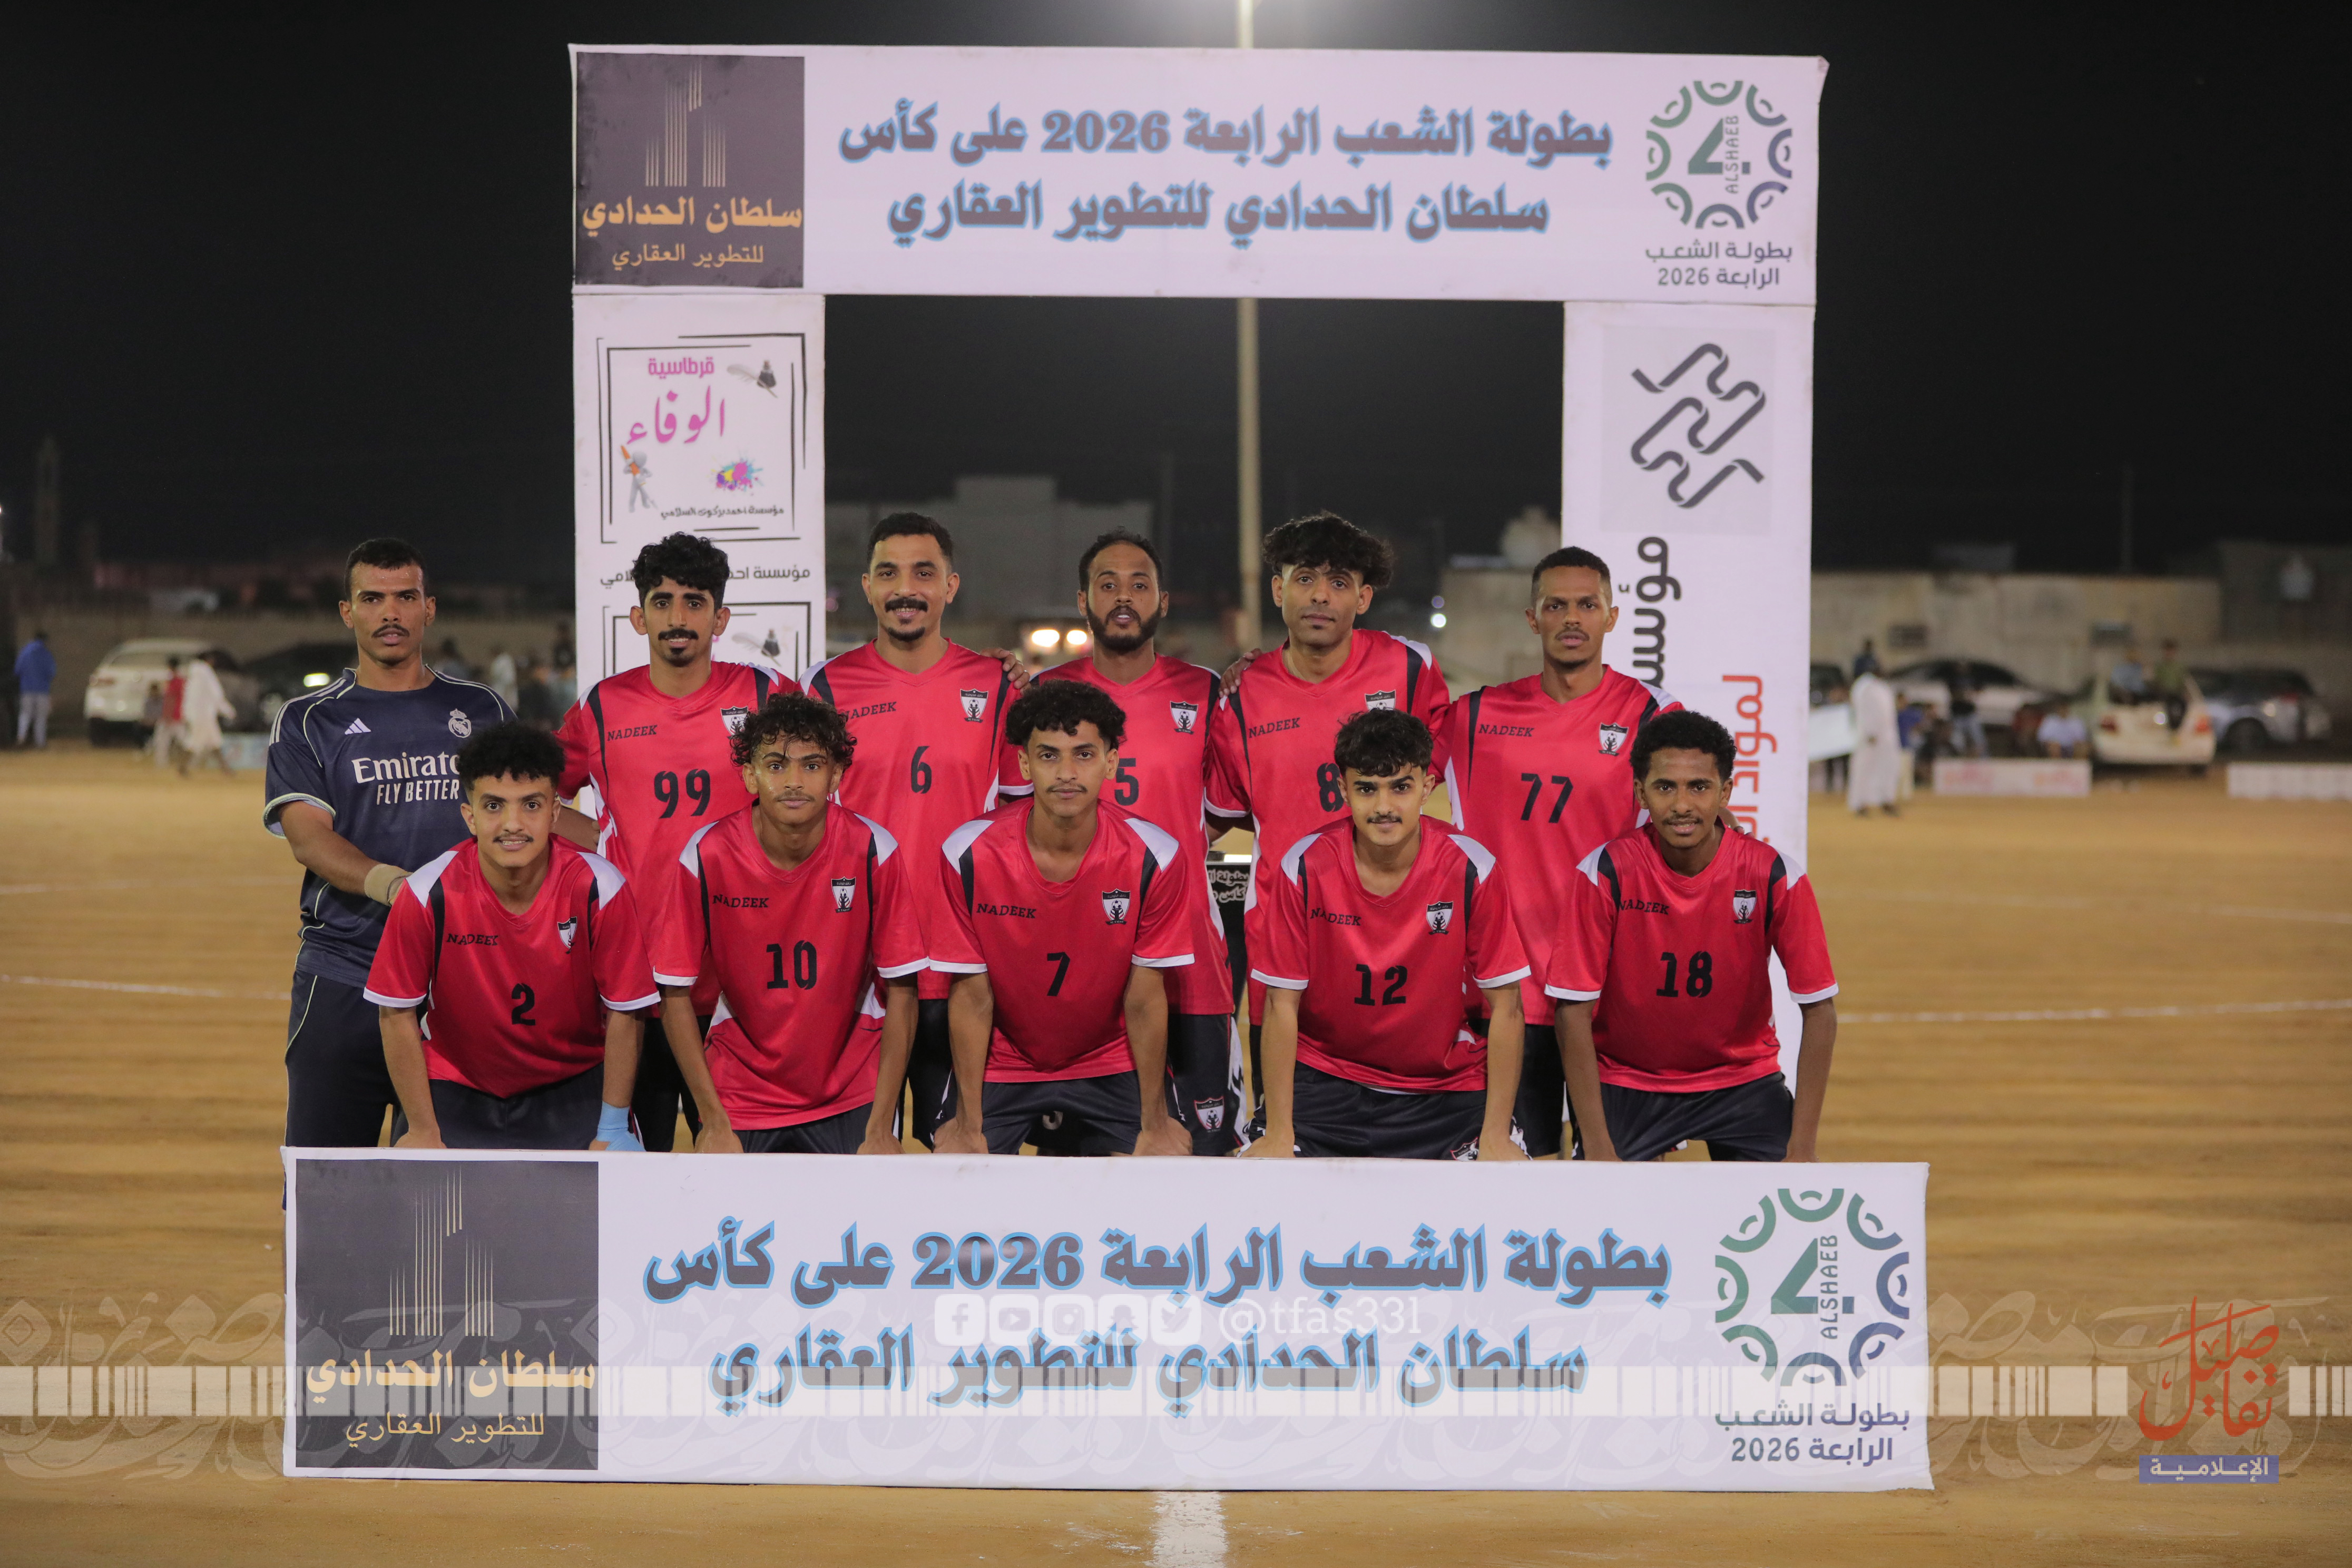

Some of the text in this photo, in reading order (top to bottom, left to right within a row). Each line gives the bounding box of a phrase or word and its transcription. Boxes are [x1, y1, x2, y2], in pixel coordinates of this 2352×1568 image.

[839, 98, 1613, 169] بطولة الشعب الرابعة 2026 على كأس
[1724, 115, 1739, 194] ALSHAEB
[582, 195, 803, 237] سلطان الحدادي
[888, 179, 1550, 250] سلطان الحدادي للتطوير العقاري
[612, 243, 763, 271] للتطوير العقاري
[1658, 267, 1779, 290] الرابعة 2026
[648, 356, 714, 379] قرطاسية
[627, 385, 725, 445] الوفاء
[728, 566, 749, 580] احم
[753, 564, 810, 582] مؤسسة
[1619, 536, 1681, 689] مؤسس
[839, 702, 897, 720] NADEEK
[1249, 717, 1300, 739] NADEEK
[1478, 723, 1534, 738] NADEEK
[607, 724, 658, 742] NADEEK
[1722, 675, 1777, 793] لمواد
[910, 746, 932, 793] 6
[1114, 758, 1139, 806] 5
[1317, 762, 1345, 812] 8
[376, 779, 459, 805] FLY BETTER
[654, 769, 711, 818] 99
[1521, 773, 1573, 824] 77
[713, 894, 769, 909] NADEEK
[976, 903, 1036, 919] NADEEK
[1310, 908, 1361, 926] NADEEK
[446, 933, 498, 946] NADEEK
[766, 940, 817, 991] 10
[1046, 952, 1071, 996] 7
[1354, 963, 1408, 1006] 12
[1657, 951, 1712, 998] 18
[511, 983, 536, 1026] 2
[643, 1217, 1671, 1309] بطولة الشعب الرابعة 2026 على كأس
[1820, 1234, 1838, 1339] ALSHAEB
[306, 1349, 595, 1404] سلطان الحدادي
[708, 1322, 1587, 1418] سلطان الحدادي للتطوير العقاري
[346, 1413, 544, 1448] للتطوير العقاري
[1731, 1437, 1893, 1467] الرابعة 2026
